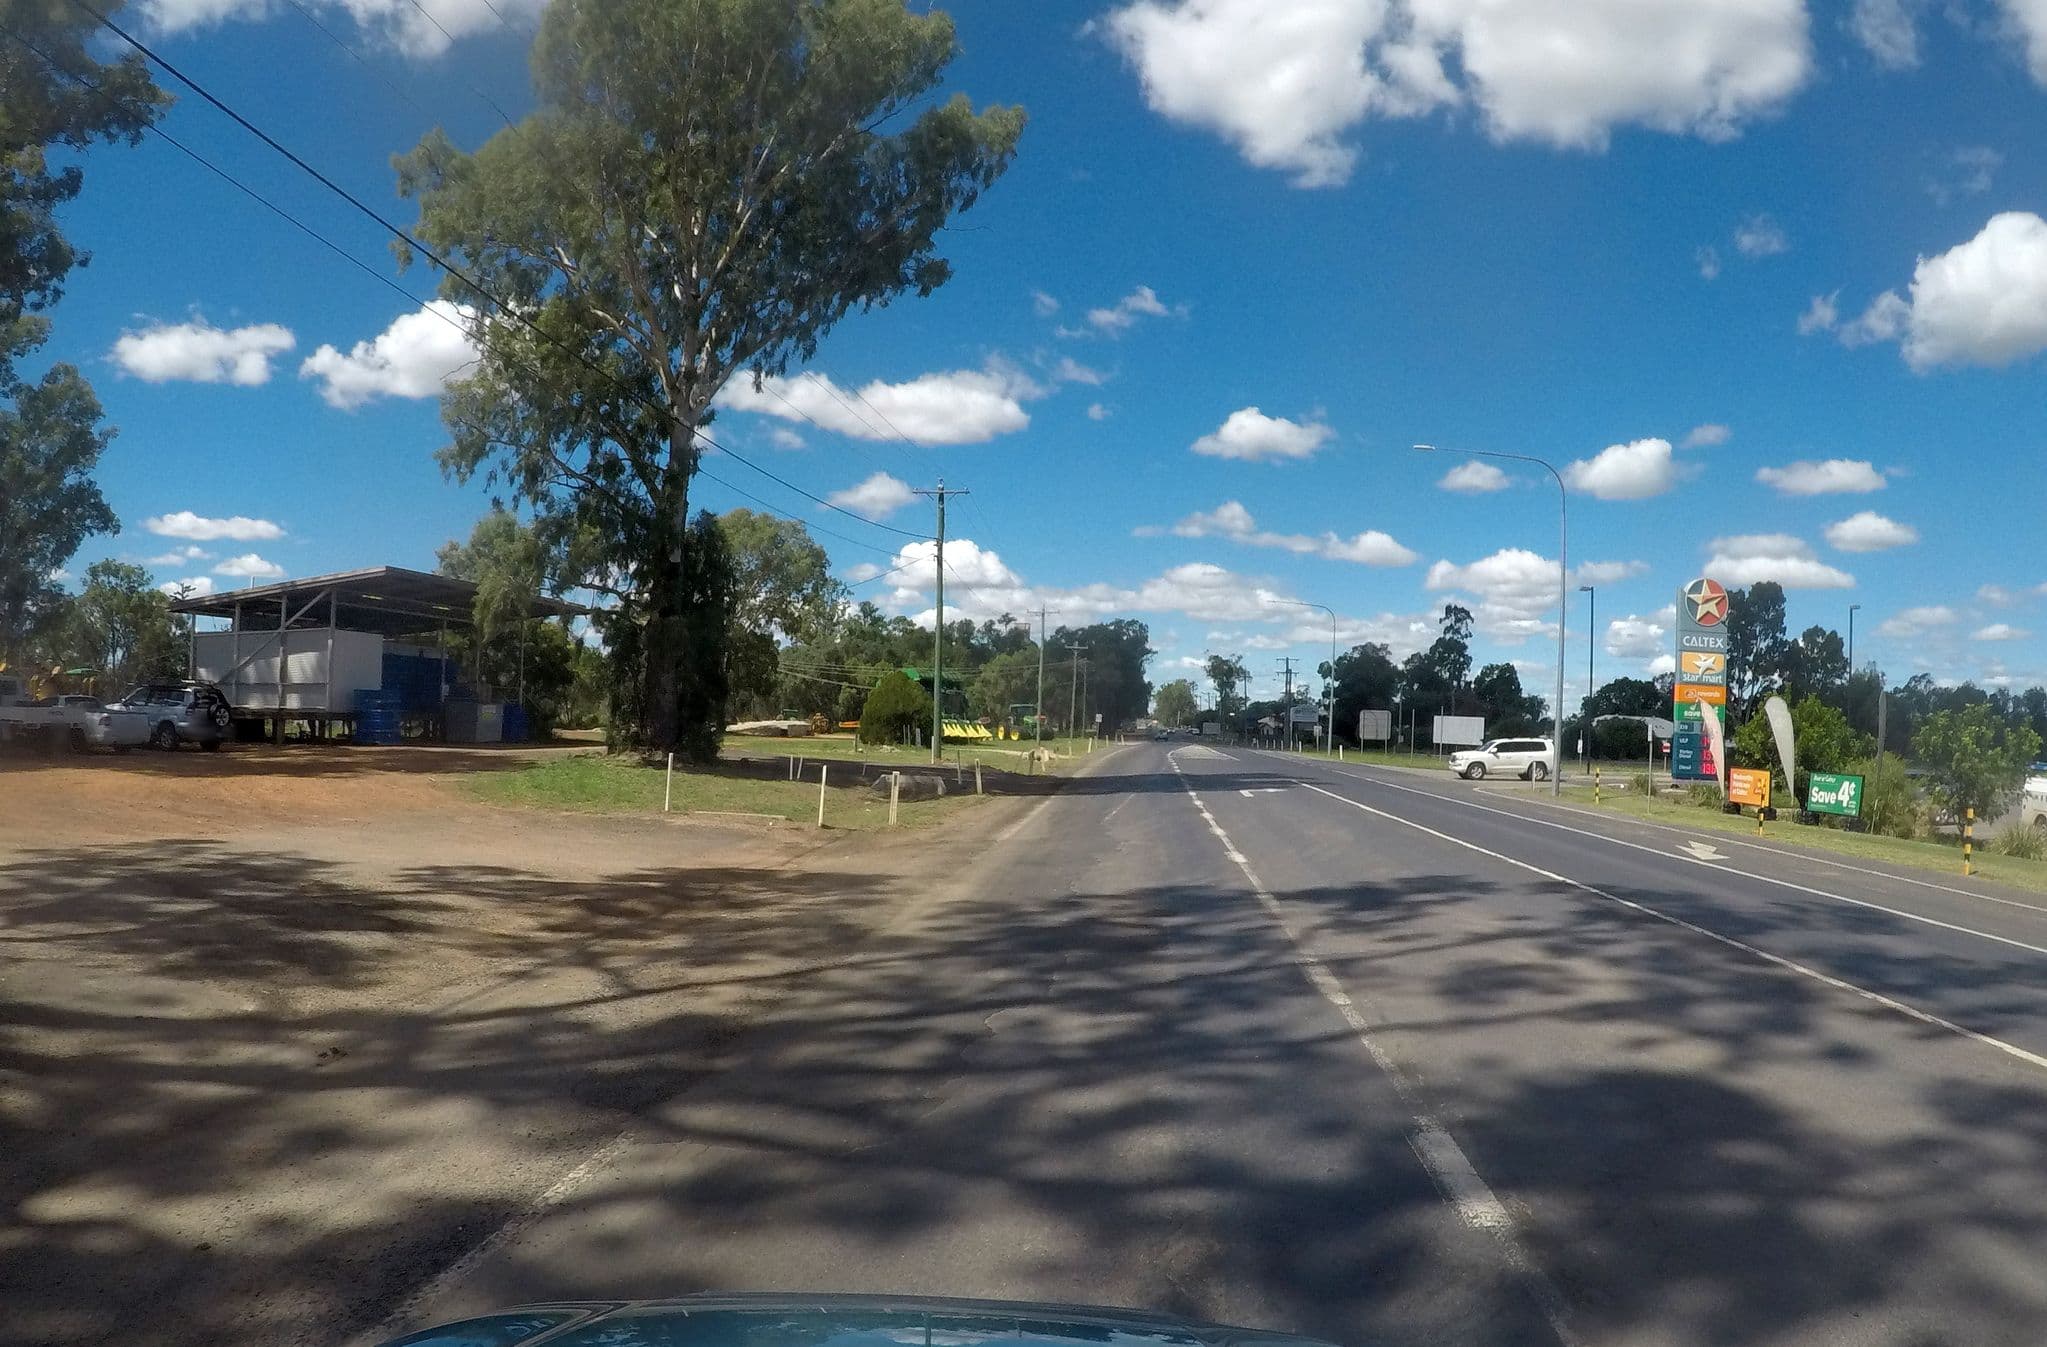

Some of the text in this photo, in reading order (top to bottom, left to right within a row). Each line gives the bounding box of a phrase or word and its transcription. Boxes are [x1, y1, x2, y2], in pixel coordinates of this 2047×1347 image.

[1683, 635, 1724, 648] CALTEX
[1703, 675, 1722, 683] mart
[1811, 786, 1837, 804] Save
